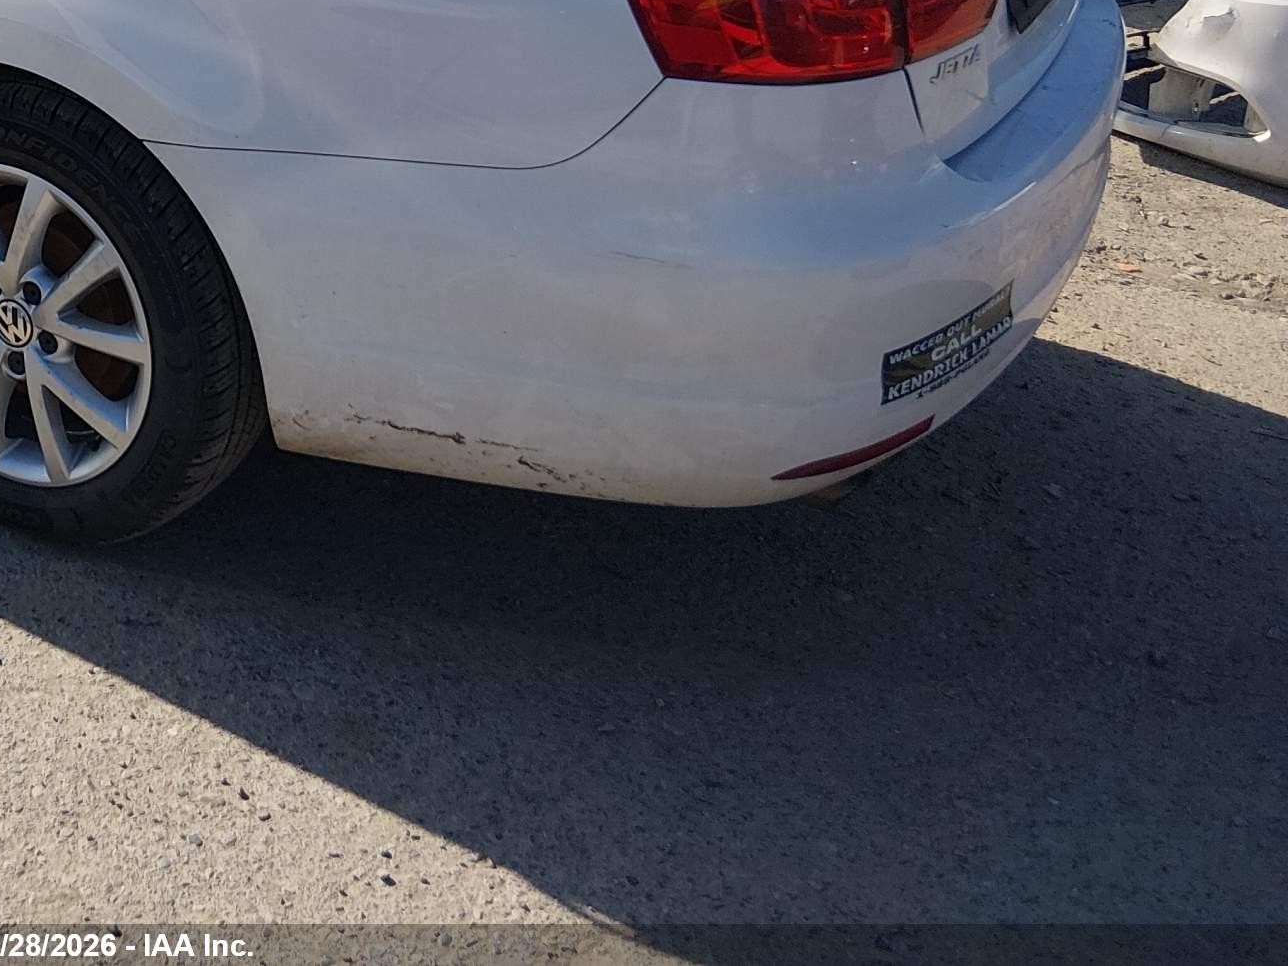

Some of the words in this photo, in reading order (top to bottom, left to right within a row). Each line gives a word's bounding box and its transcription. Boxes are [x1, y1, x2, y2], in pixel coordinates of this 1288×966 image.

[930, 324, 982, 362] CALL
[946, 317, 971, 337] OUT
[888, 348, 969, 401] KENDRICK
[971, 317, 1011, 355] LAMAR
